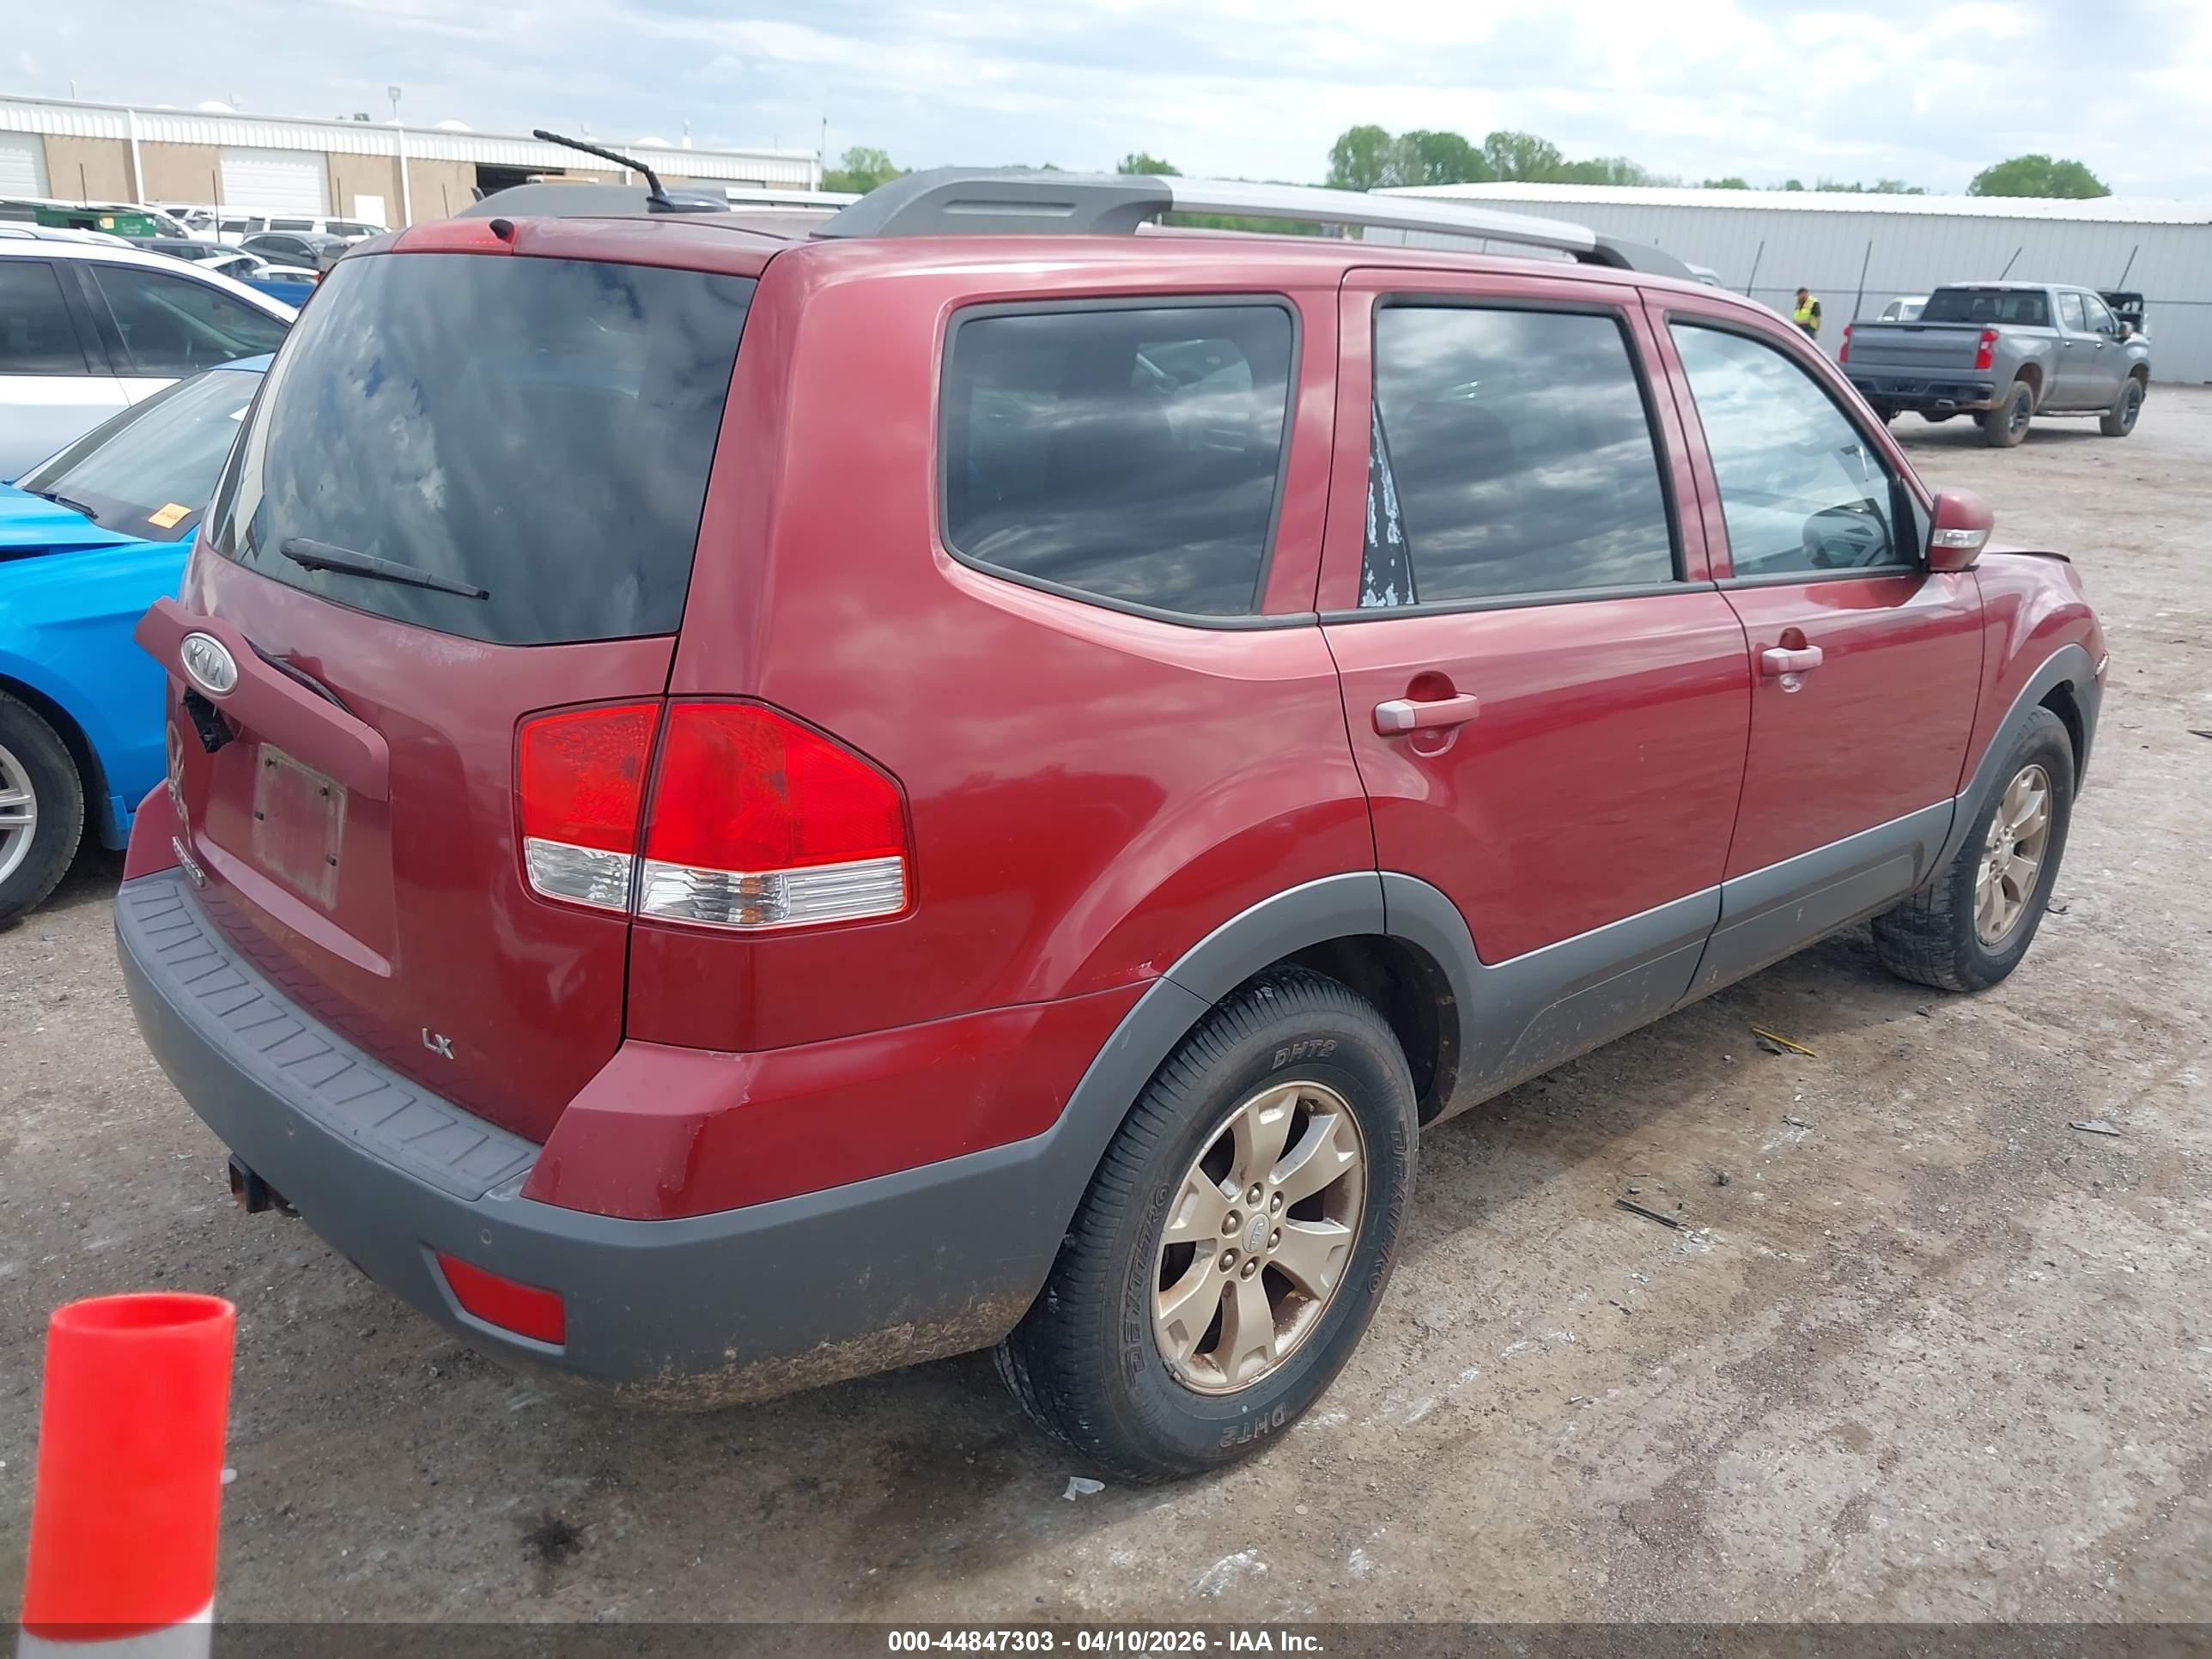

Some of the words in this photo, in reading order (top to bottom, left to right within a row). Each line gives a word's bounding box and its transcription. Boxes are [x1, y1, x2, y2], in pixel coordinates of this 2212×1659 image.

[189, 639, 226, 687] KIA
[422, 1028, 454, 1060] LX
[1271, 1039, 1338, 1071] DHT2
[1219, 1401, 1288, 1449] DHT2
